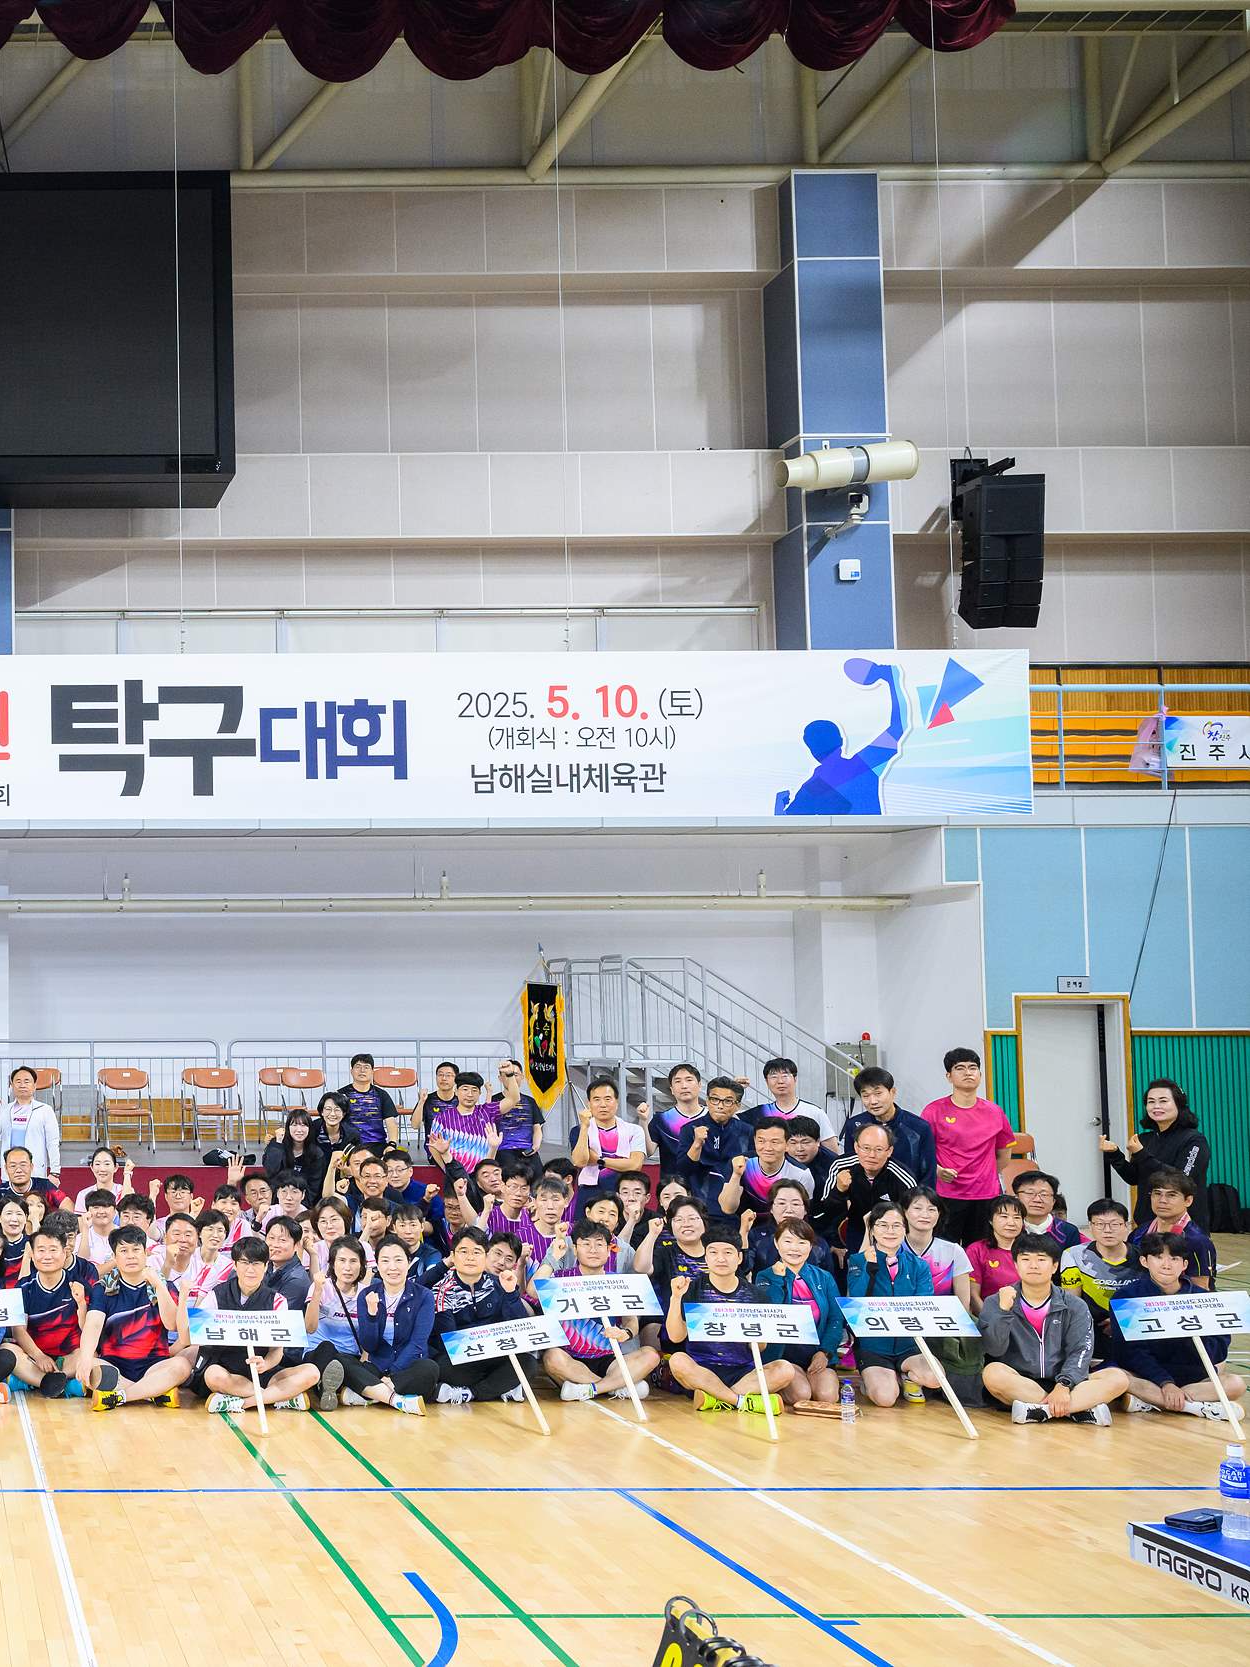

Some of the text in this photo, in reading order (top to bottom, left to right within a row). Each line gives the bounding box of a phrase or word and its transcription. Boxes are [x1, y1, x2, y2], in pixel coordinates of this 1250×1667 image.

[457, 684, 703, 720] 2025. 5. 10. (토)
[488, 726, 556, 750] (개회식
[576, 726, 616, 750] 오전
[625, 725, 676, 750] 10시)
[471, 763, 667, 794] 남해실내체육관
[557, 1295, 645, 1313] 거창군
[704, 1322, 799, 1338] 창녕군
[865, 1316, 960, 1331] 의령군
[1139, 1313, 1243, 1333] 고성군
[205, 1327, 291, 1342] 남해군
[463, 1332, 550, 1357] 산청군
[1142, 1543, 1222, 1591] TAGRO
